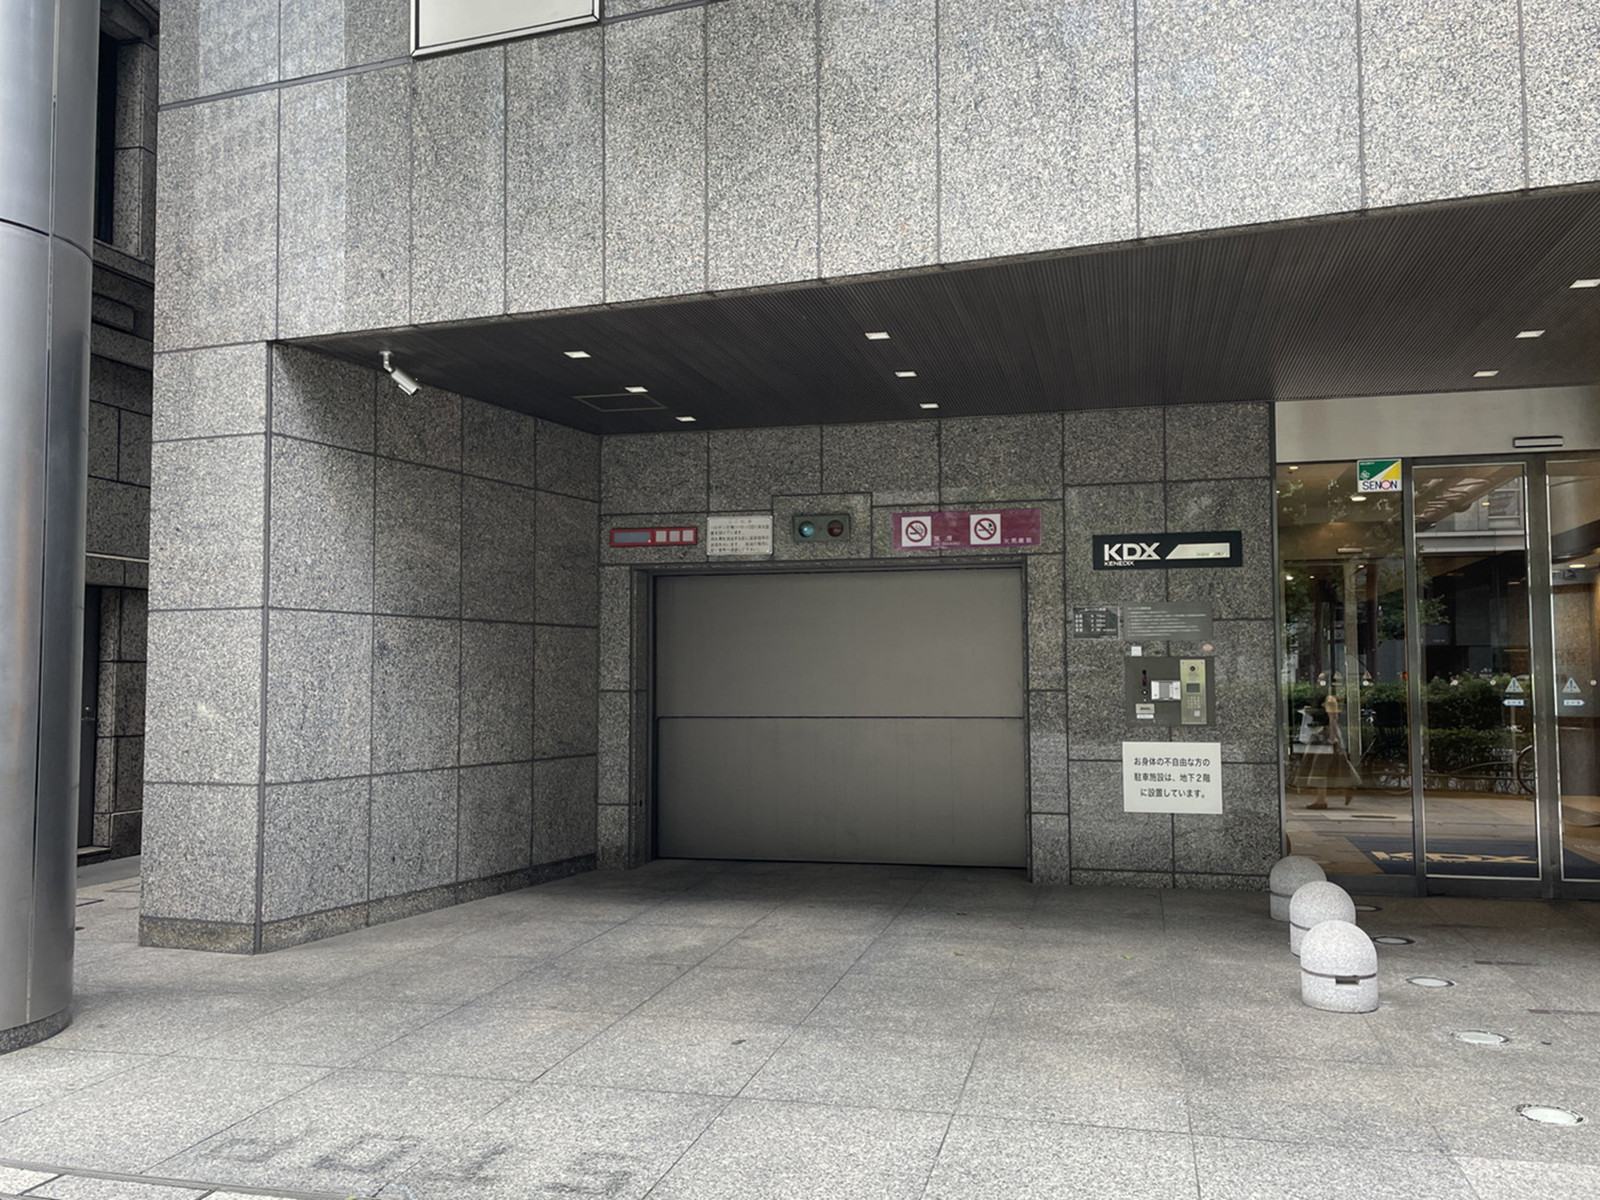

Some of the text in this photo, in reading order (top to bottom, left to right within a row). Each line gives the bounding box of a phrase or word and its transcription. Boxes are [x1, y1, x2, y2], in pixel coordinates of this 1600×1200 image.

[1362, 479, 1397, 490] SENON
[1104, 542, 1161, 561] KDX
[1133, 757, 1211, 767] お身体の不自由な方の
[1140, 788, 1206, 799] に設置しています。
